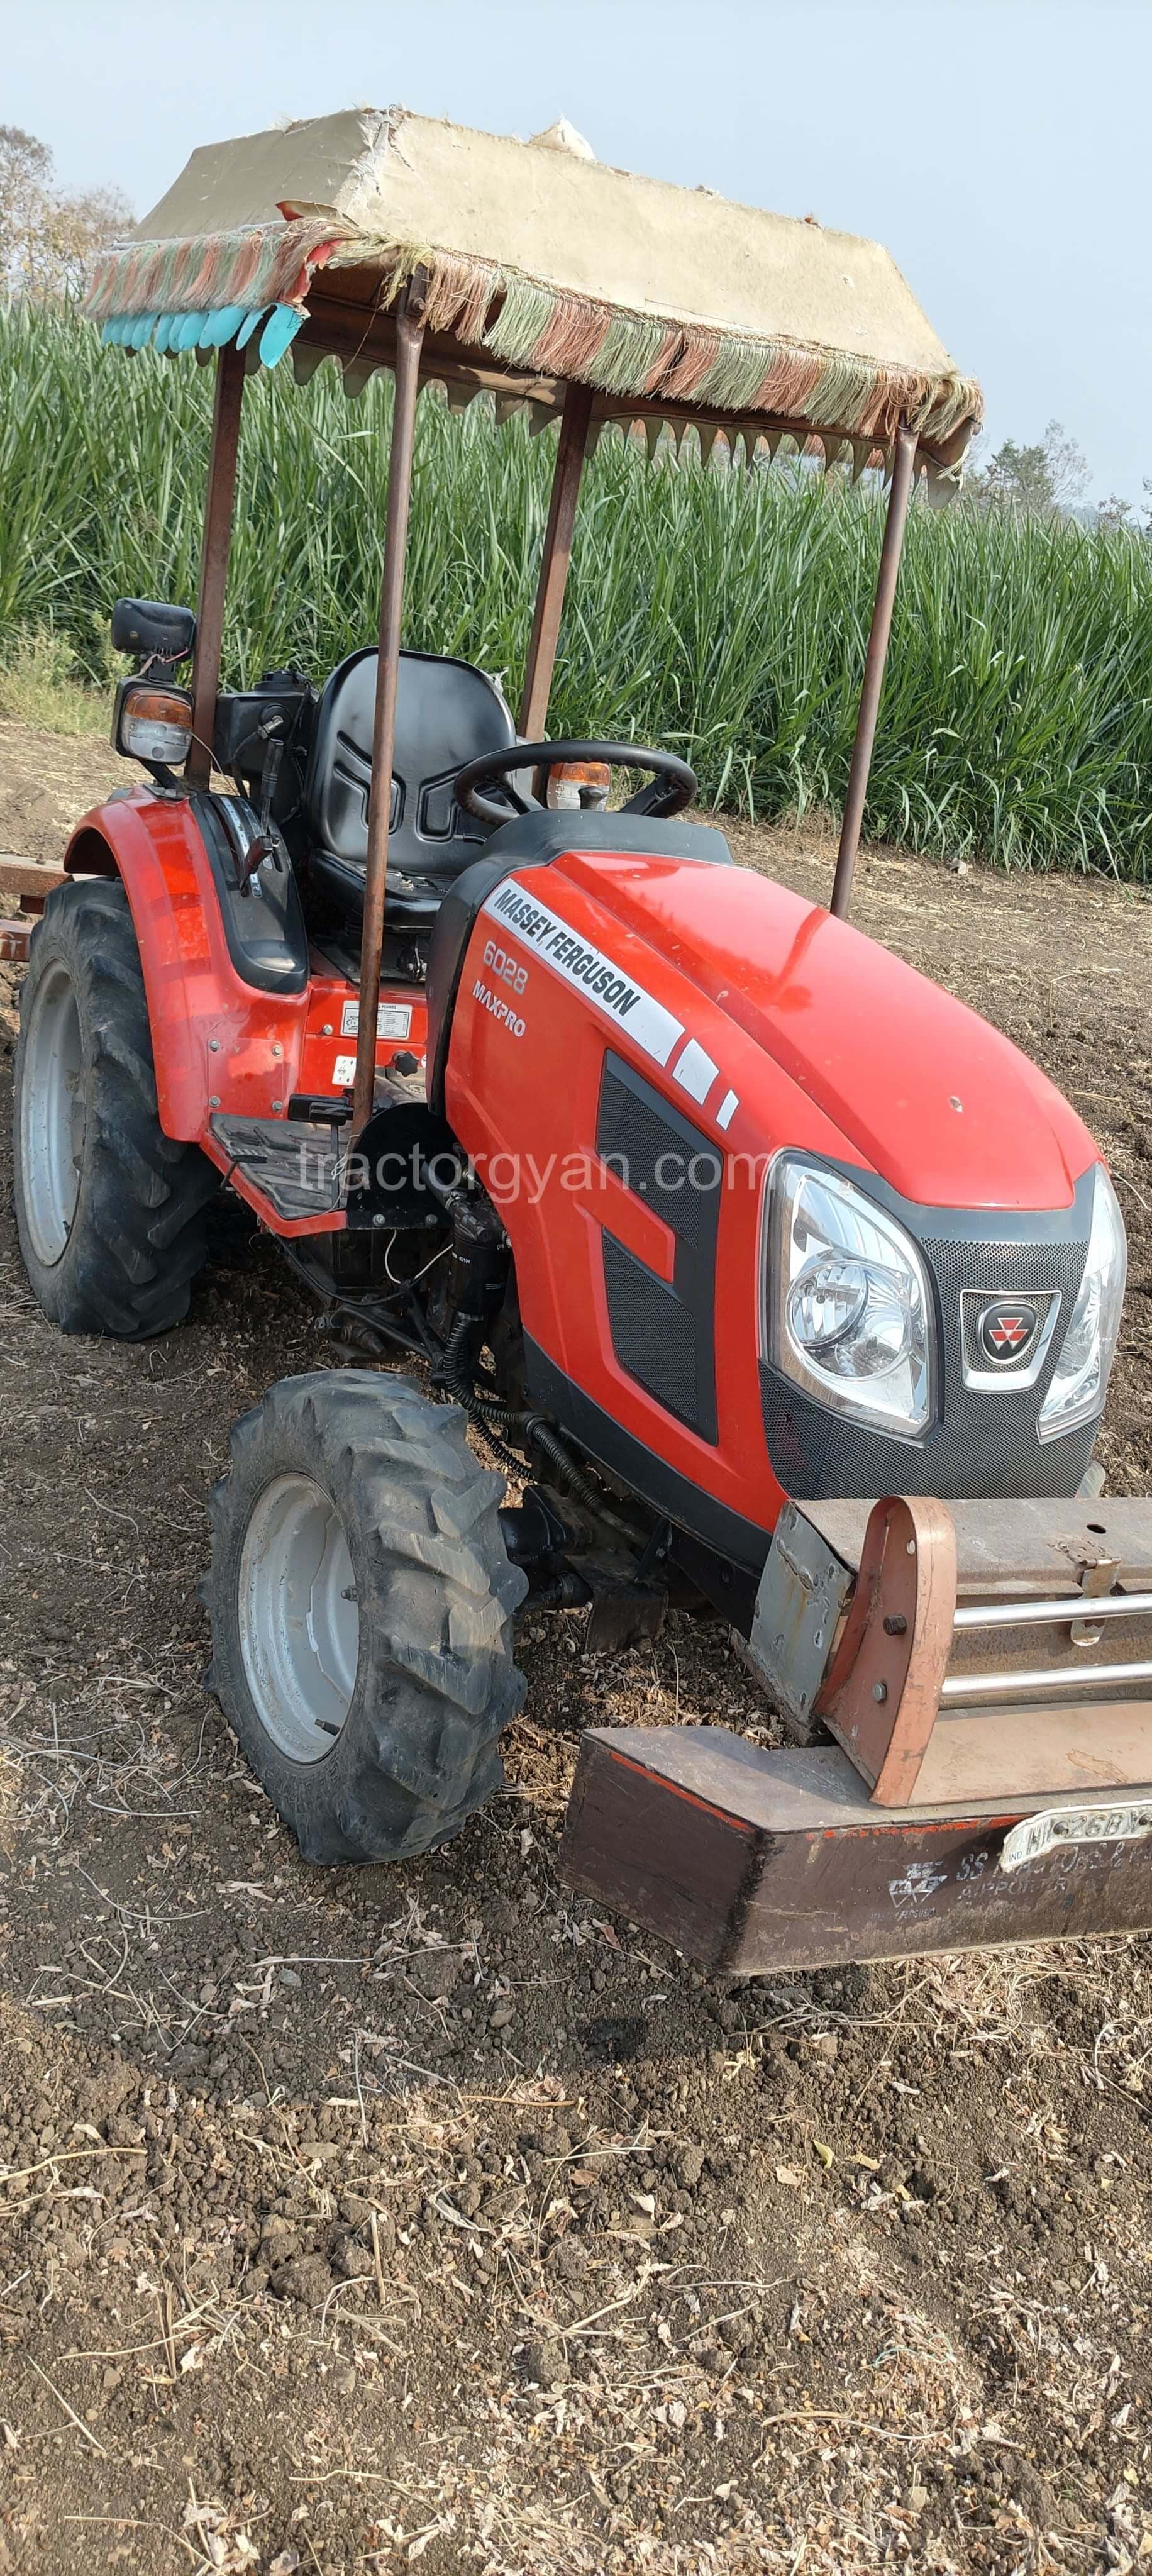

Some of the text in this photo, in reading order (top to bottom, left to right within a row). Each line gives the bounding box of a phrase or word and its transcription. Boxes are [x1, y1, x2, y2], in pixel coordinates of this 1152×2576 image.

[483, 940, 528, 996] 6028
[494, 888, 641, 1017] MASSEY FERGUSON
[472, 980, 526, 1038] MAXPRO
[1009, 1850, 1022, 1862] IND
